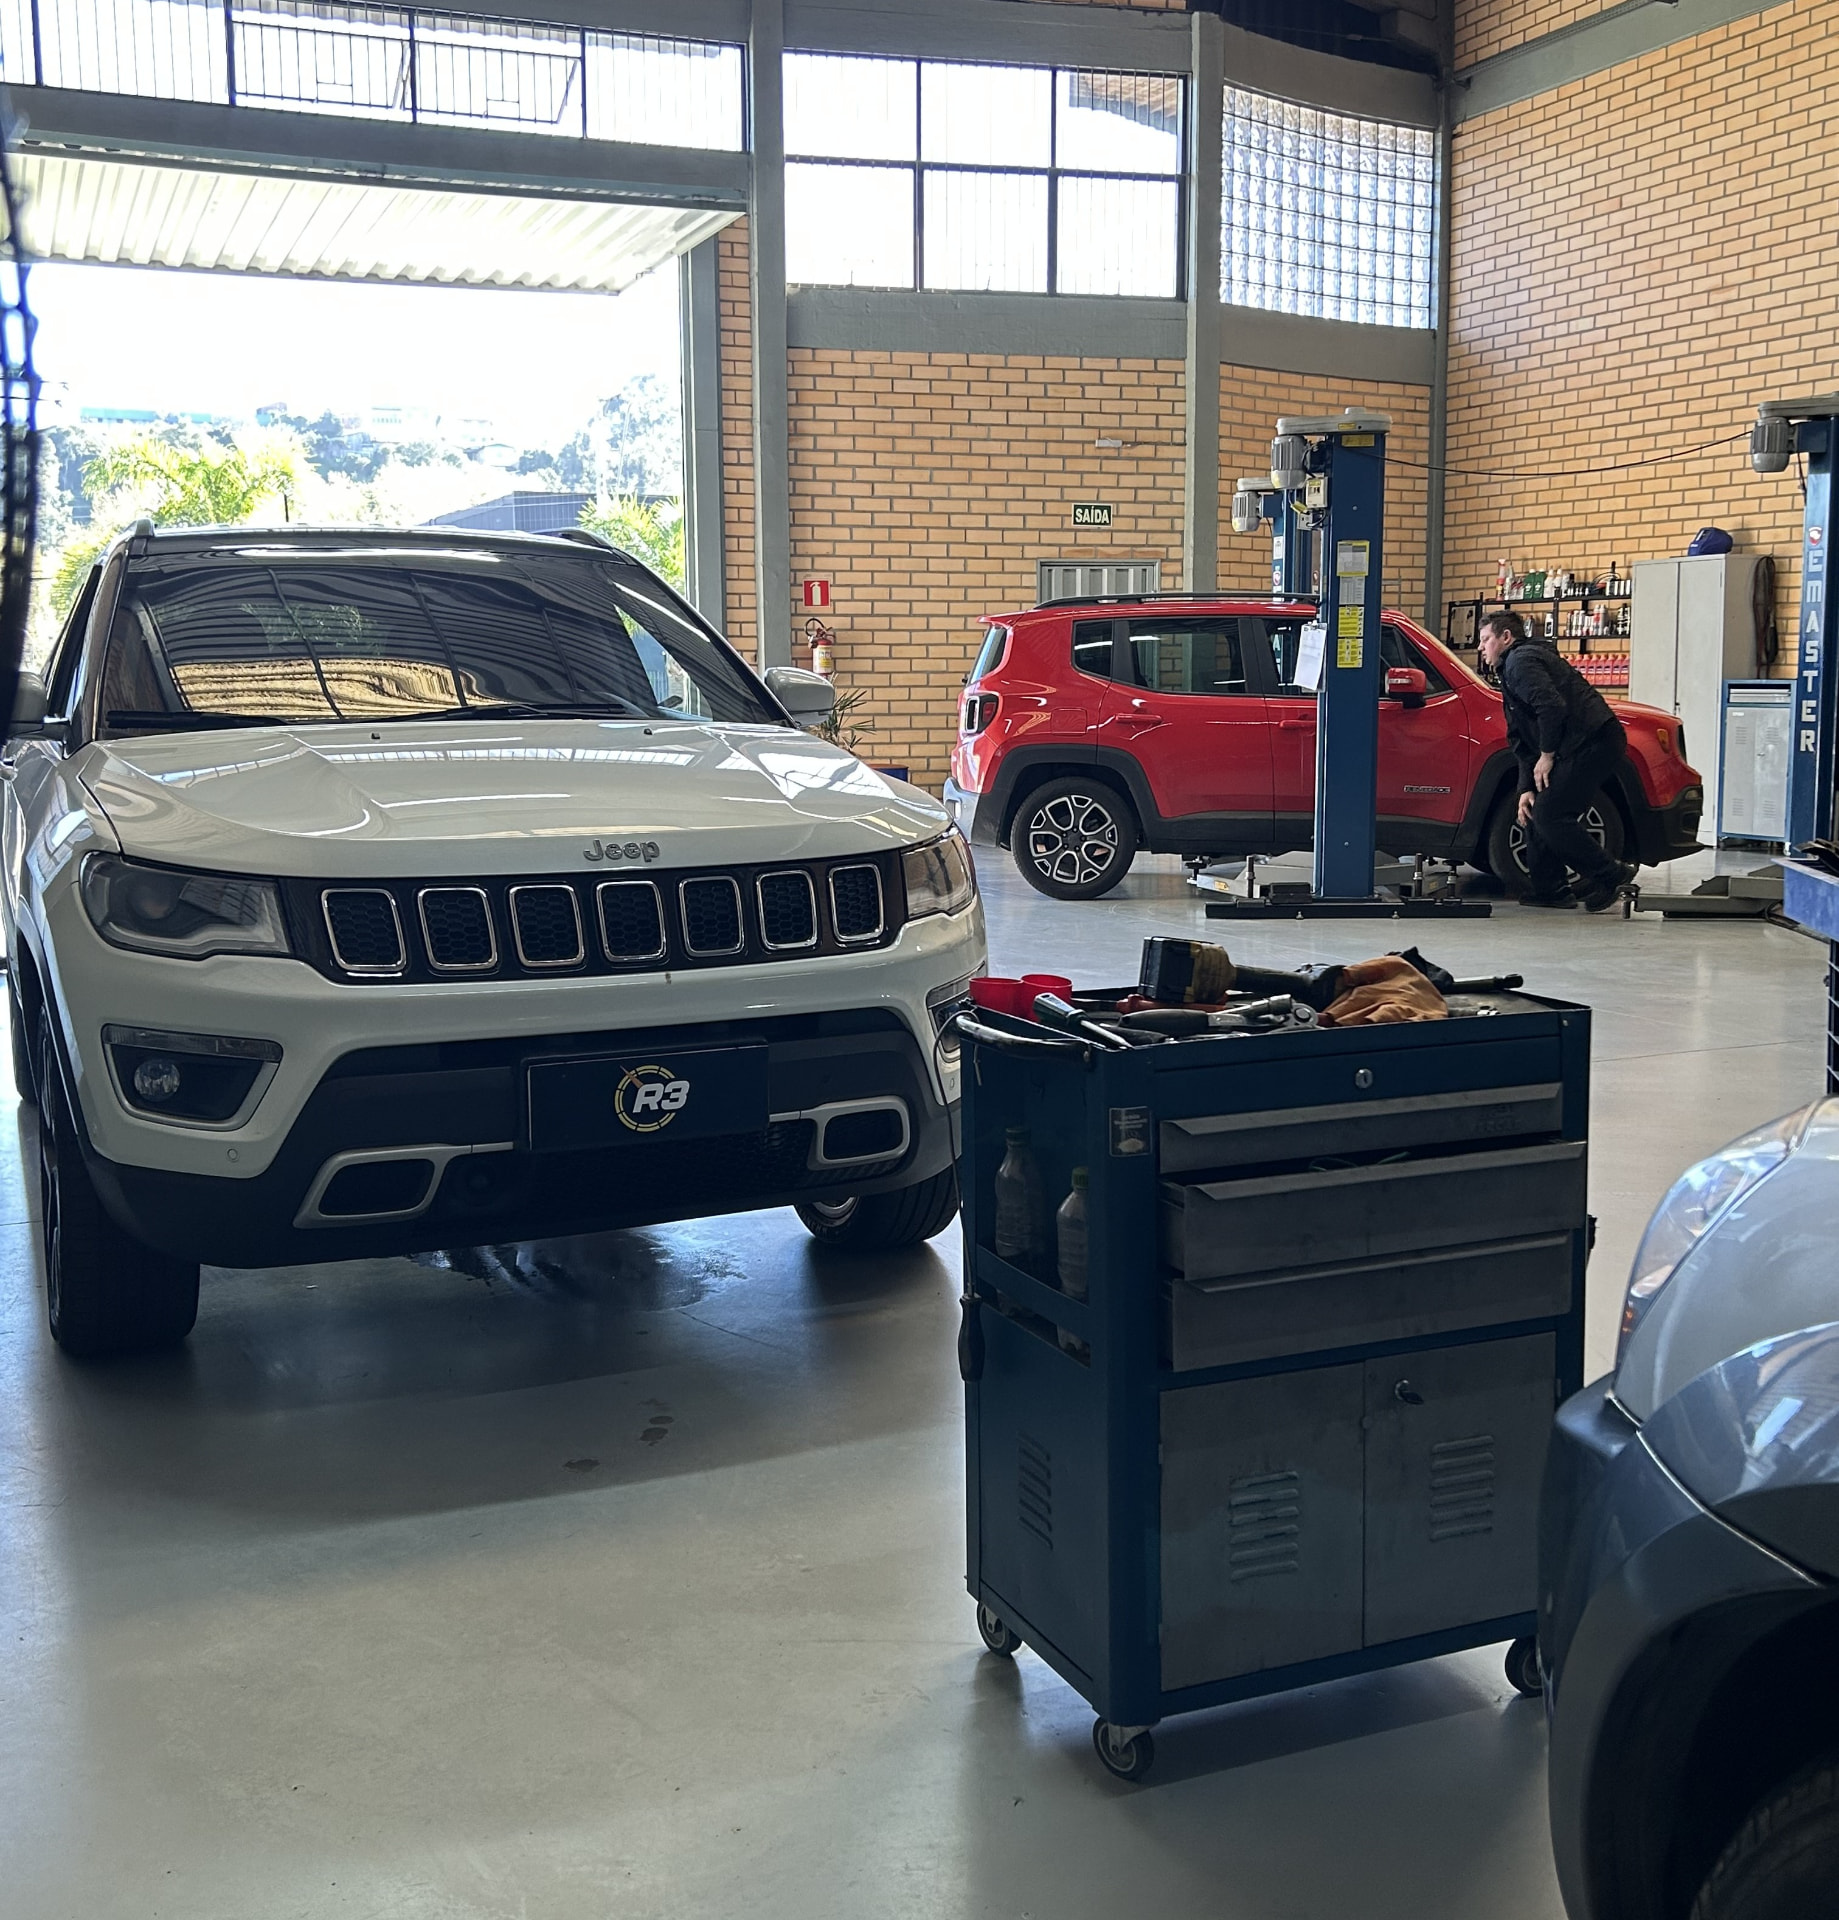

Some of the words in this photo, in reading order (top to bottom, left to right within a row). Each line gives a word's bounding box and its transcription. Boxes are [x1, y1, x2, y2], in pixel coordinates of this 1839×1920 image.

[1075, 506, 1110, 524] SAÍDA
[583, 839, 660, 862] Jeep
[633, 1080, 690, 1113] R3
